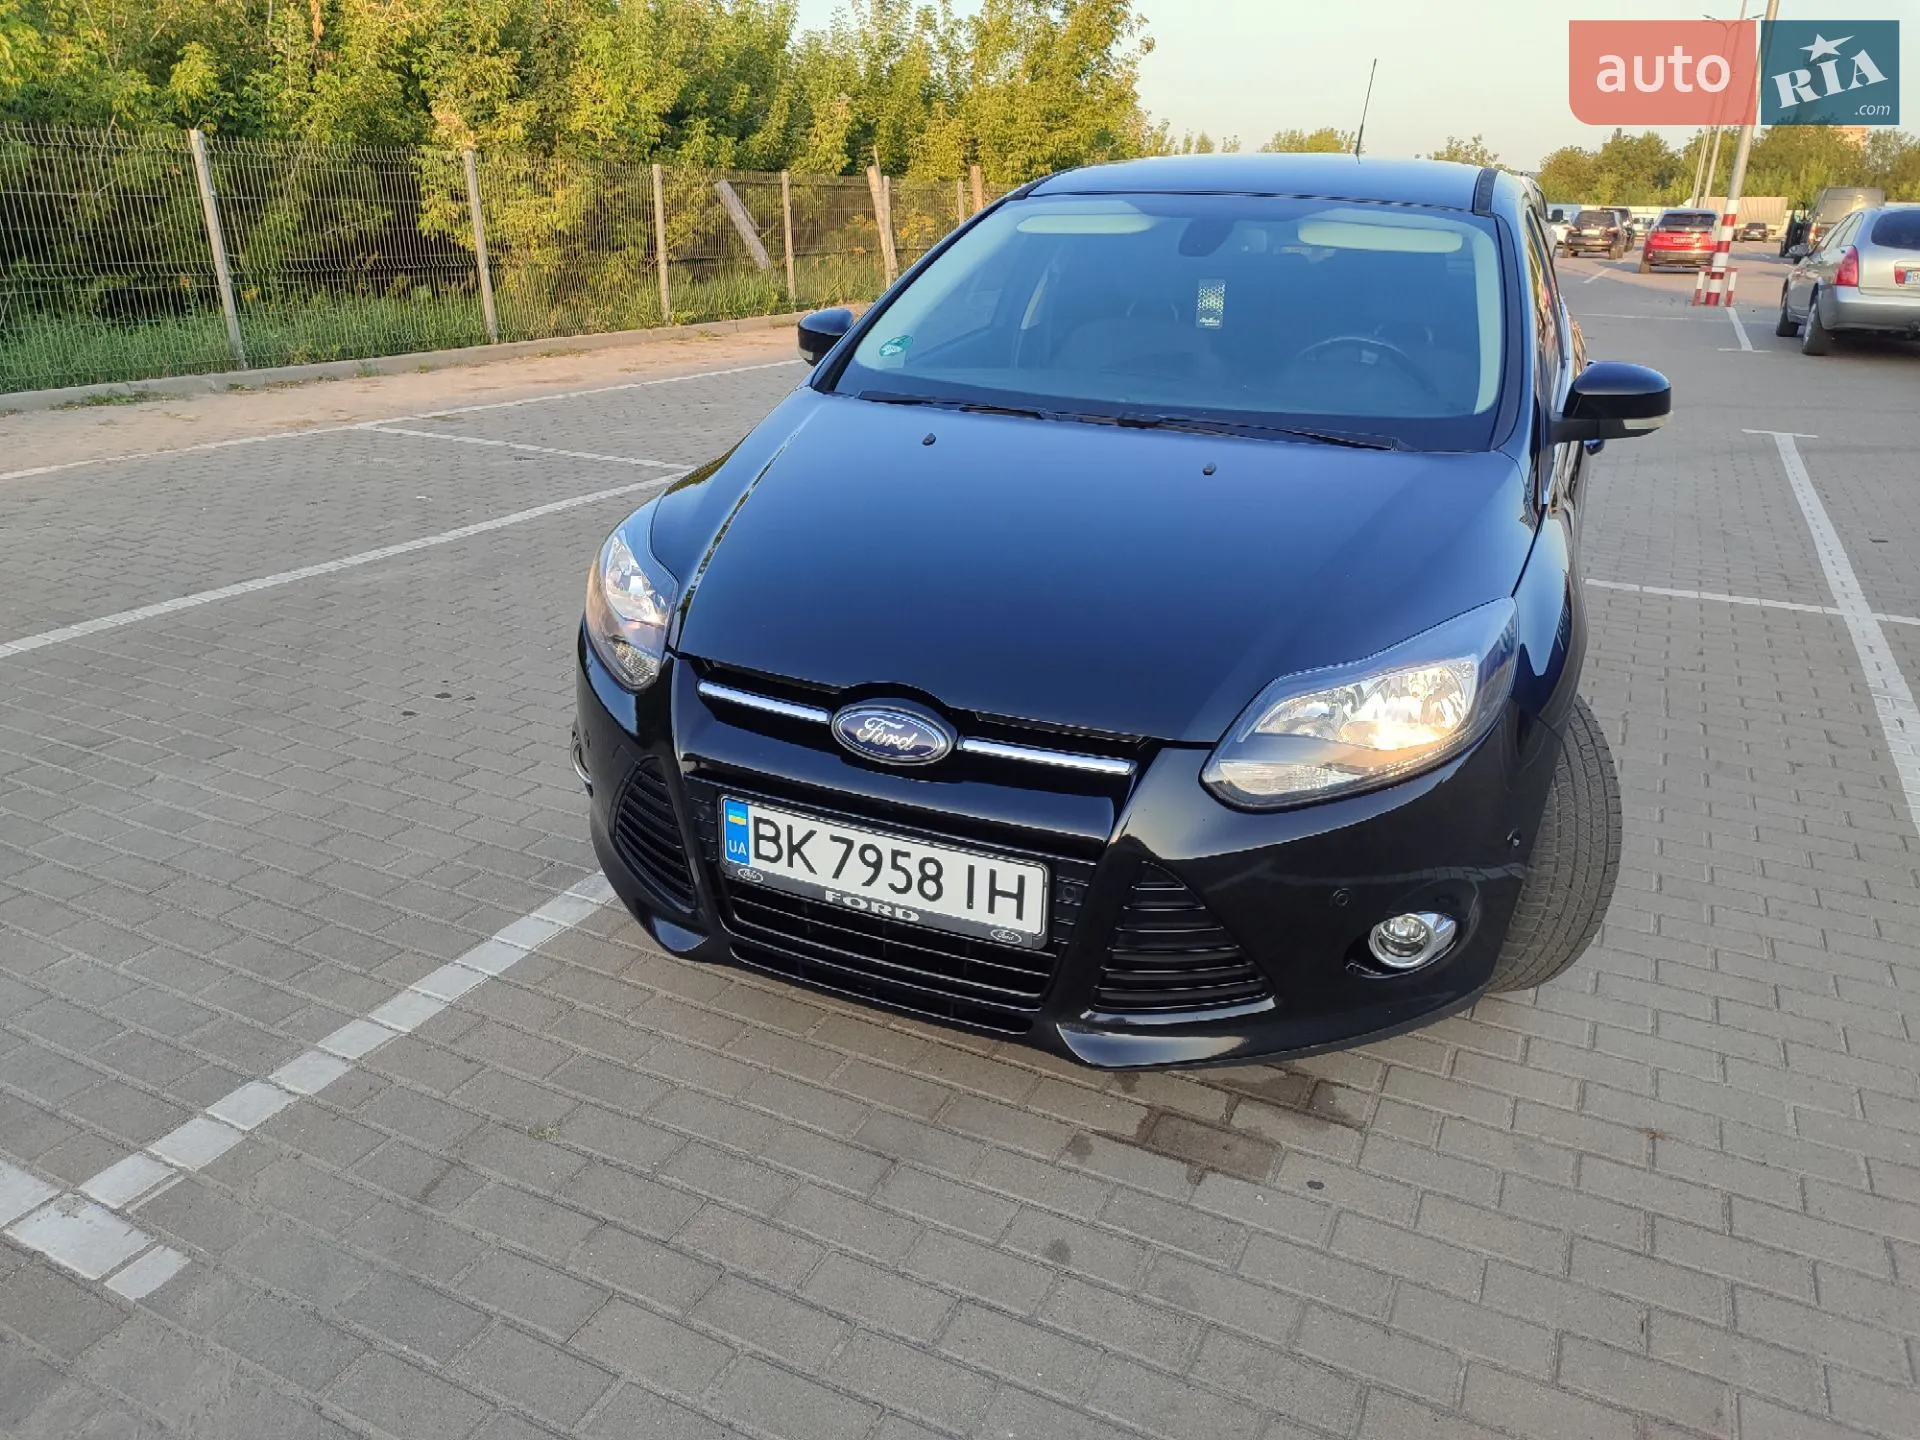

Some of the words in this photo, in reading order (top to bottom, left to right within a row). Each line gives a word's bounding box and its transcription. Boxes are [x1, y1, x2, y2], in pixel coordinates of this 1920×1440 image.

[856, 717, 918, 751] Ford
[728, 839, 747, 856] UA
[753, 816, 817, 875] BK
[829, 835, 944, 902] 7958
[966, 864, 1025, 920] IH
[824, 890, 920, 922] FORD
